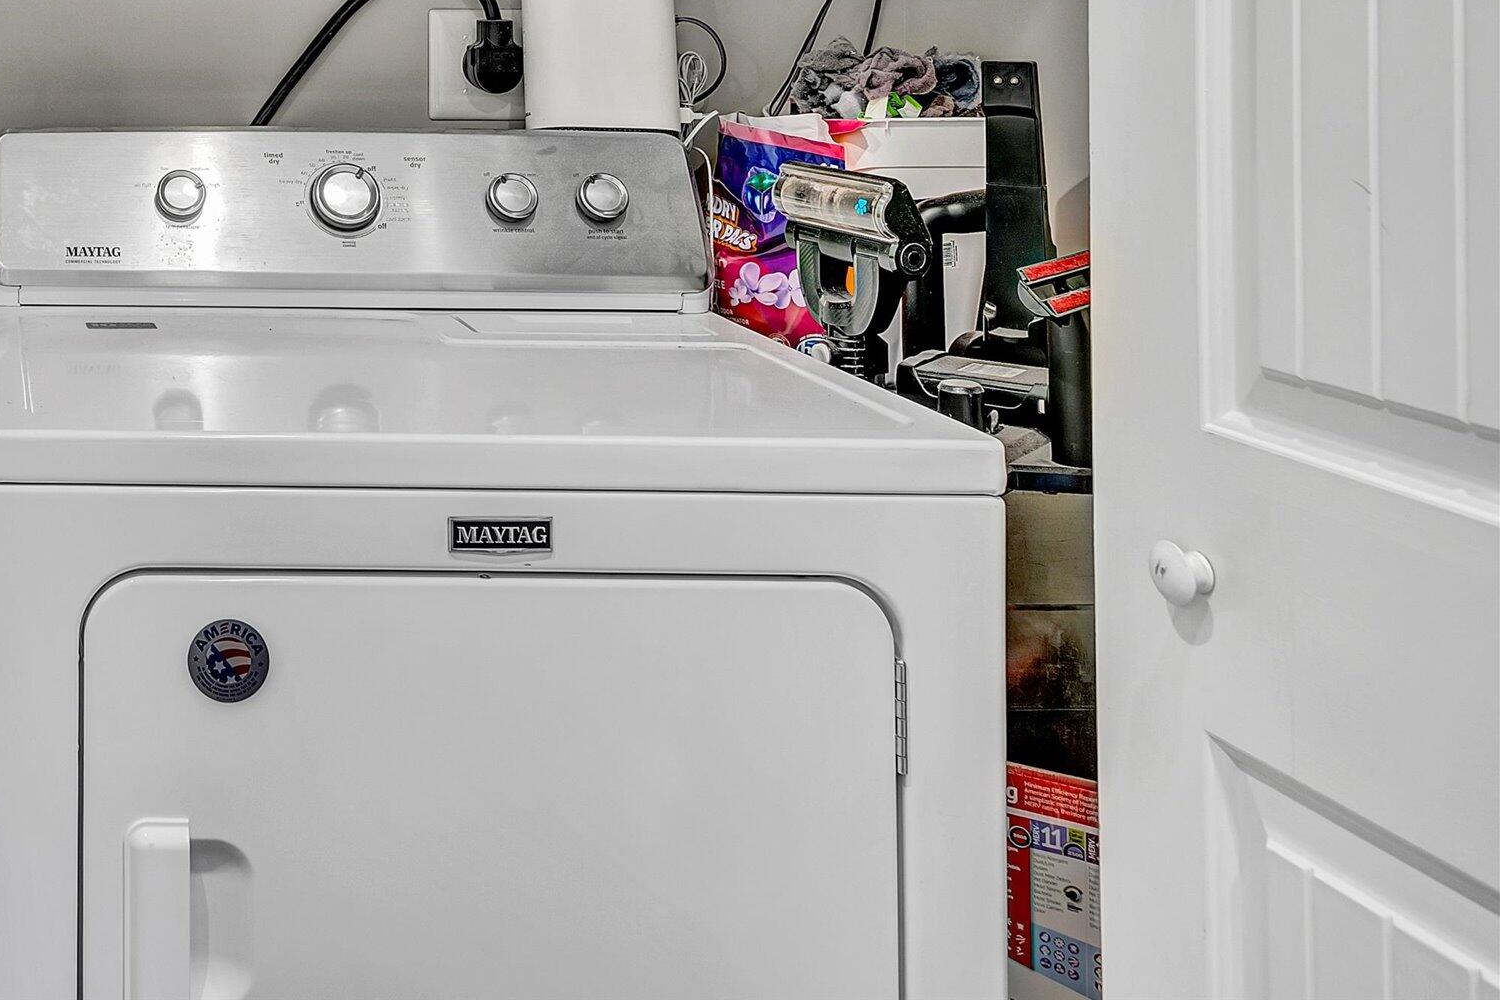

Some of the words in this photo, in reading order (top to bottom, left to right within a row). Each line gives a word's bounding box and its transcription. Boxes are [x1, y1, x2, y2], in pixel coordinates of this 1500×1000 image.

[65, 246, 121, 257] MAYTAG
[456, 527, 548, 544] MAYTAG
[195, 622, 263, 656] AMERICA
[1041, 826, 1061, 849] 11
